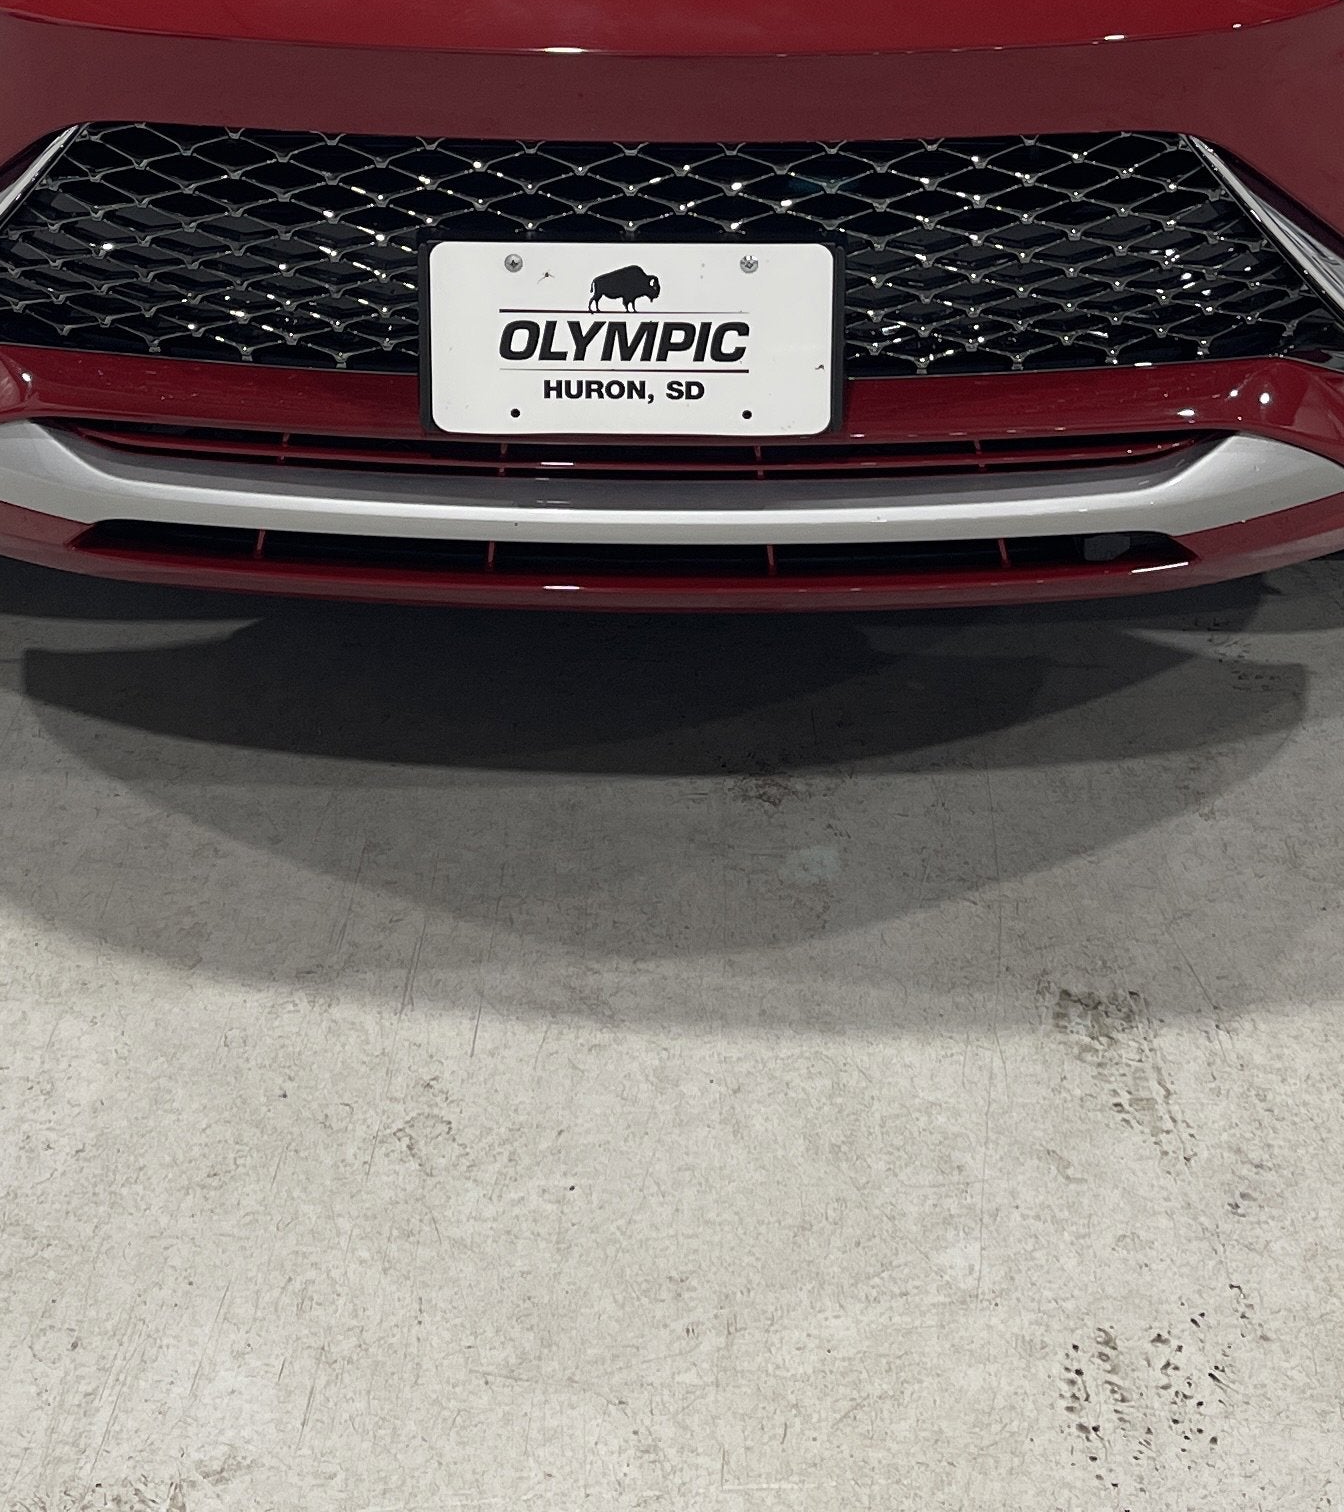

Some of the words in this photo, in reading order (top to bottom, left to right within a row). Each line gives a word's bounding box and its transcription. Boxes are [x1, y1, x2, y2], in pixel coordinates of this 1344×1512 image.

[499, 319, 750, 363] OLYMPIC
[543, 379, 655, 404] HURON,
[665, 380, 705, 400] SD
